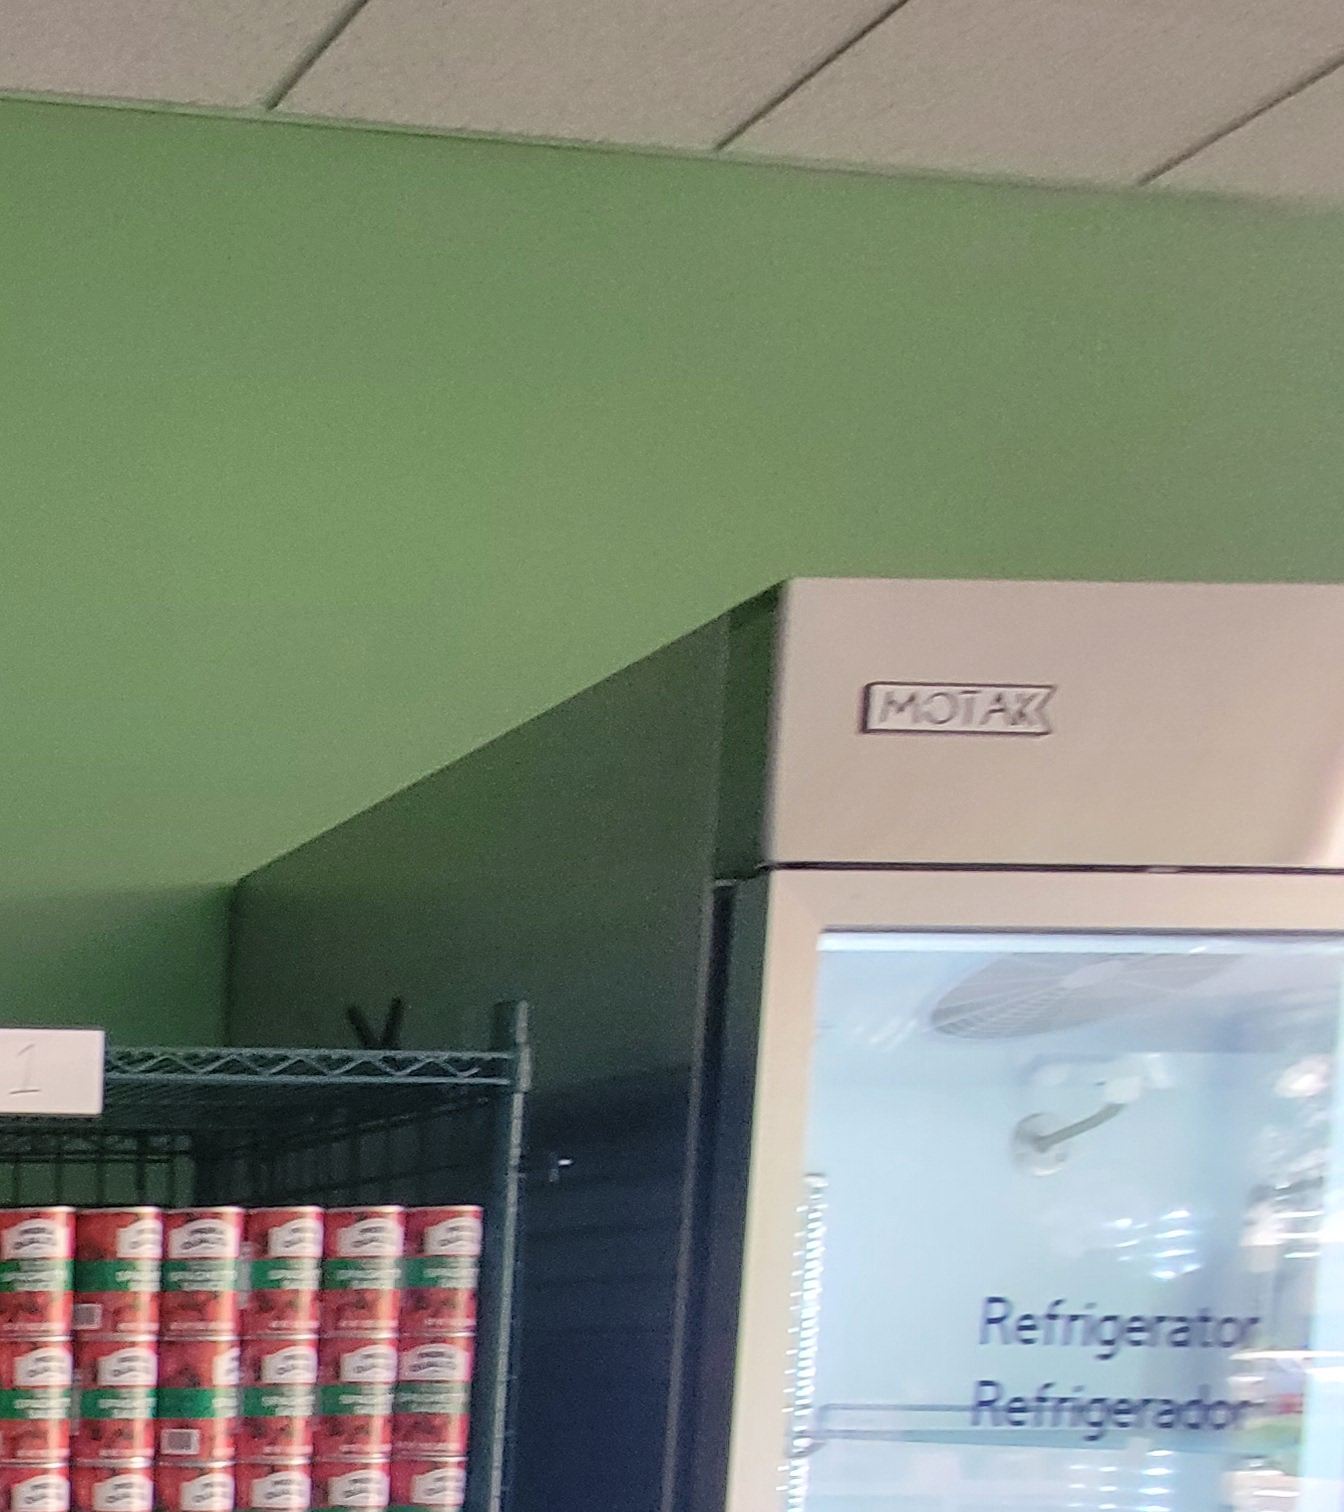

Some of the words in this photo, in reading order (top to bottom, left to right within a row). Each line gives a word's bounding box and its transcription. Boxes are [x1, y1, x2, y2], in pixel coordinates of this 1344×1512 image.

[8, 1043, 43, 1095] 1
[978, 1296, 1260, 1360] Refrigerator
[970, 1379, 1258, 1441] Refrigerador
